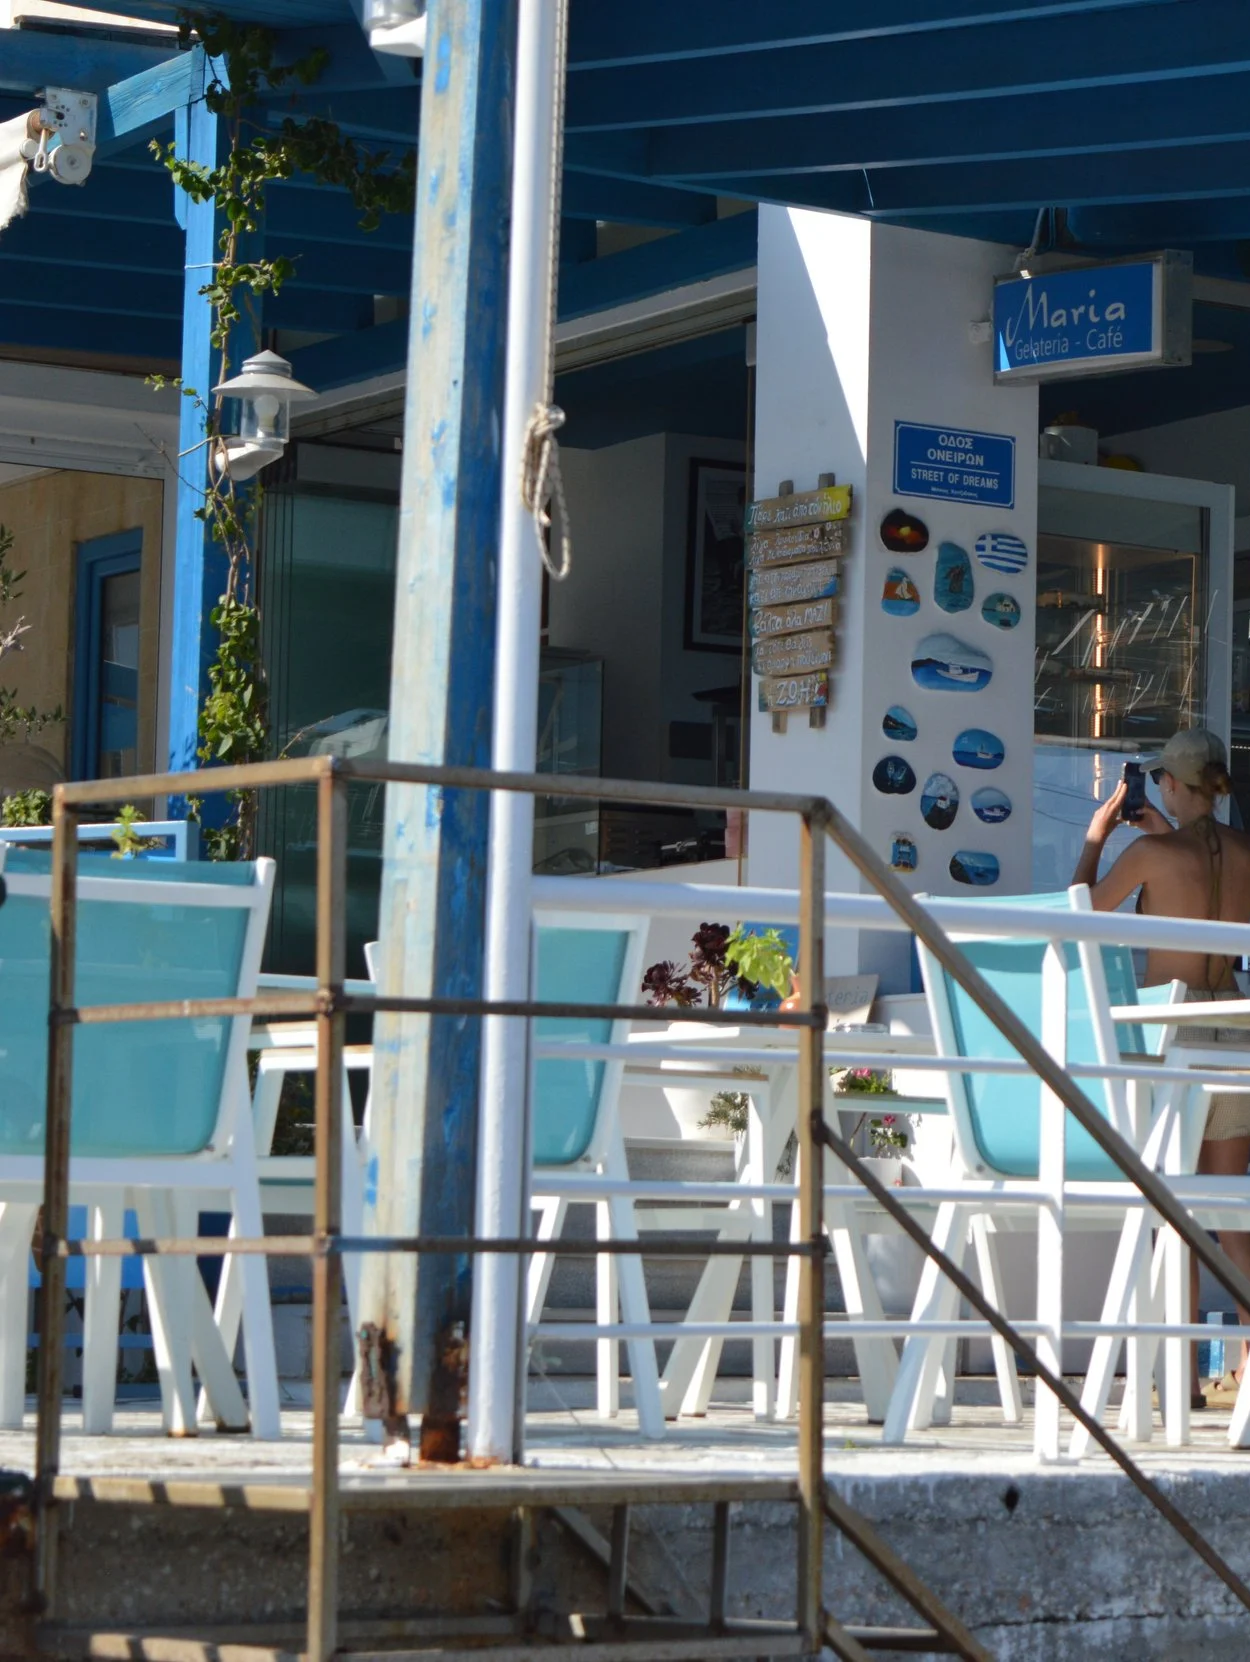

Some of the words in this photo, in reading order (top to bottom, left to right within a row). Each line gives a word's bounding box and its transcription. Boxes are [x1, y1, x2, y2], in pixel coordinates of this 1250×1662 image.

[1006, 283, 1126, 347] Maria
[1015, 333, 1069, 360] Gelateria
[1086, 326, 1123, 350] Café
[938, 434, 974, 449] ΟΔΟΣ
[927, 448, 984, 466] ΟΝΕΙΡΩΝ
[911, 468, 944, 482] STREET
[948, 473, 960, 484] OF
[963, 475, 999, 490] DREAMS
[828, 986, 869, 1006] teria
